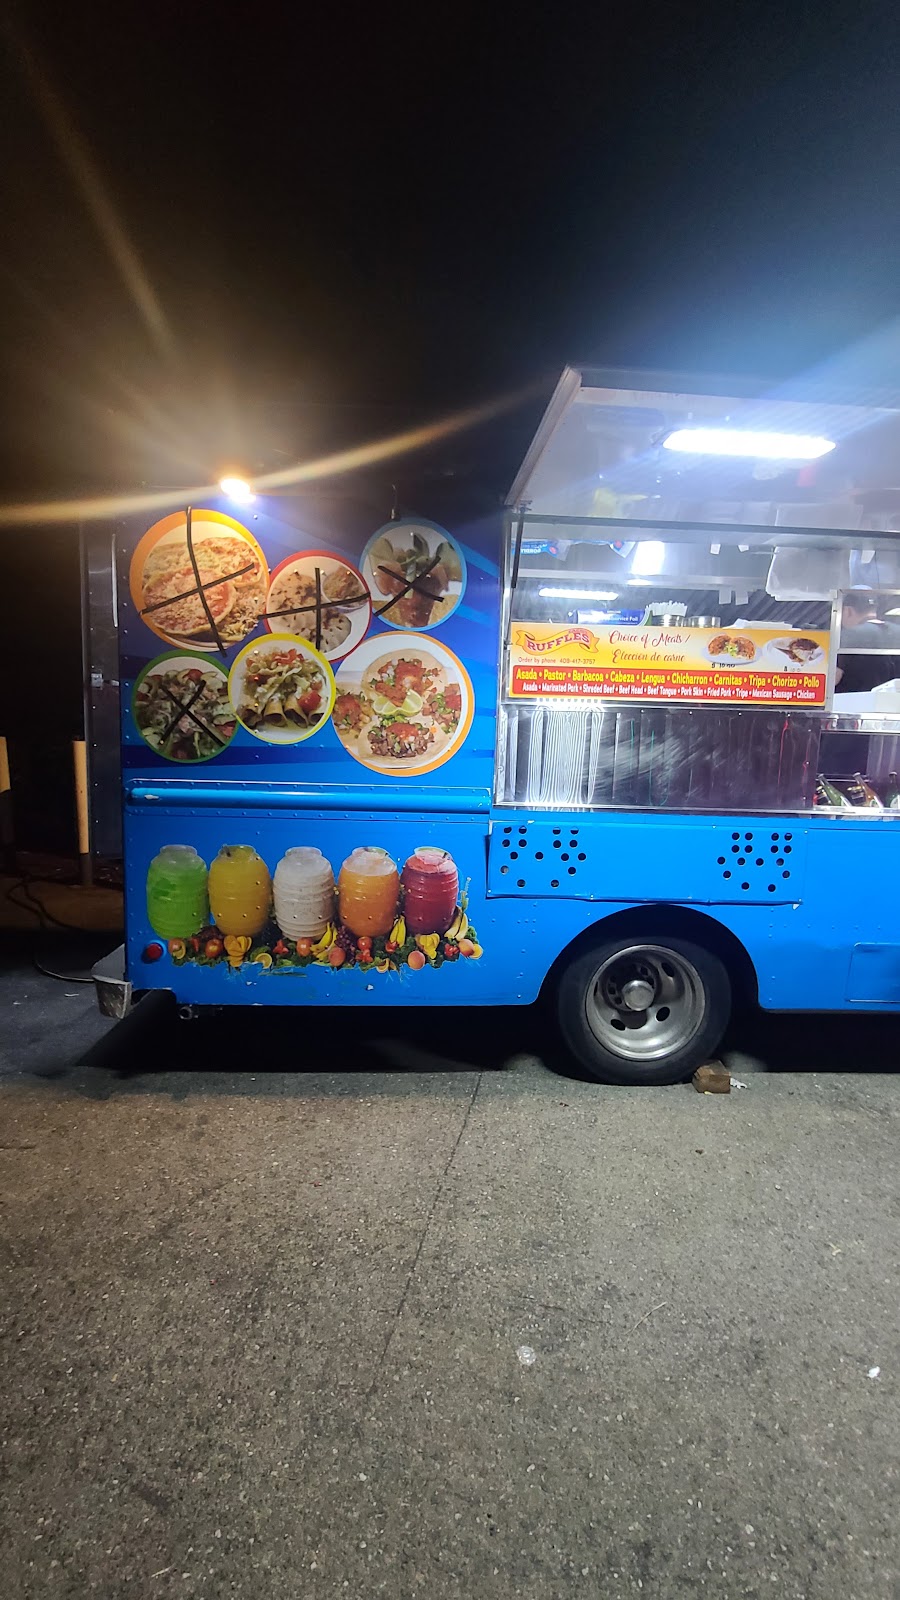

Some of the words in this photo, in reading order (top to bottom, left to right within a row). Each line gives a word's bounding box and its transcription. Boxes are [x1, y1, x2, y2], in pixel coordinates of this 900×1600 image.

[527, 632, 590, 651] RUFFLES
[608, 630, 638, 645] Choice
[640, 633, 649, 649] of
[652, 632, 682, 647] Meats
[650, 651, 661, 662] de
[663, 654, 685, 662] carne
[516, 668, 538, 680] Asada
[543, 669, 566, 681] Pastor
[572, 670, 604, 682] Barbacoa
[610, 670, 635, 683] Cabeza
[641, 672, 666, 686] Lengua
[671, 673, 708, 685] Chicharron
[714, 674, 743, 686] Carnitas
[749, 675, 766, 688] Tripa
[772, 676, 798, 688] Chorizo
[803, 676, 820, 688] Pollo
[522, 682, 538, 691] Asada
[541, 683, 567, 692] Marinated
[567, 683, 579, 693] Pork
[603, 684, 615, 694] Beef
[618, 685, 630, 694] Beef
[630, 685, 644, 695] Head
[647, 686, 659, 695] Beef
[659, 686, 677, 697] Tongue
[680, 686, 692, 696] Pork
[693, 686, 704, 696] Skin
[707, 687, 720, 697] Fried
[720, 687, 732, 697] Pork
[735, 688, 748, 698] Tripe
[752, 688, 772, 698] Mexican
[772, 689, 793, 700] Sausage
[796, 689, 815, 699] Chicken
